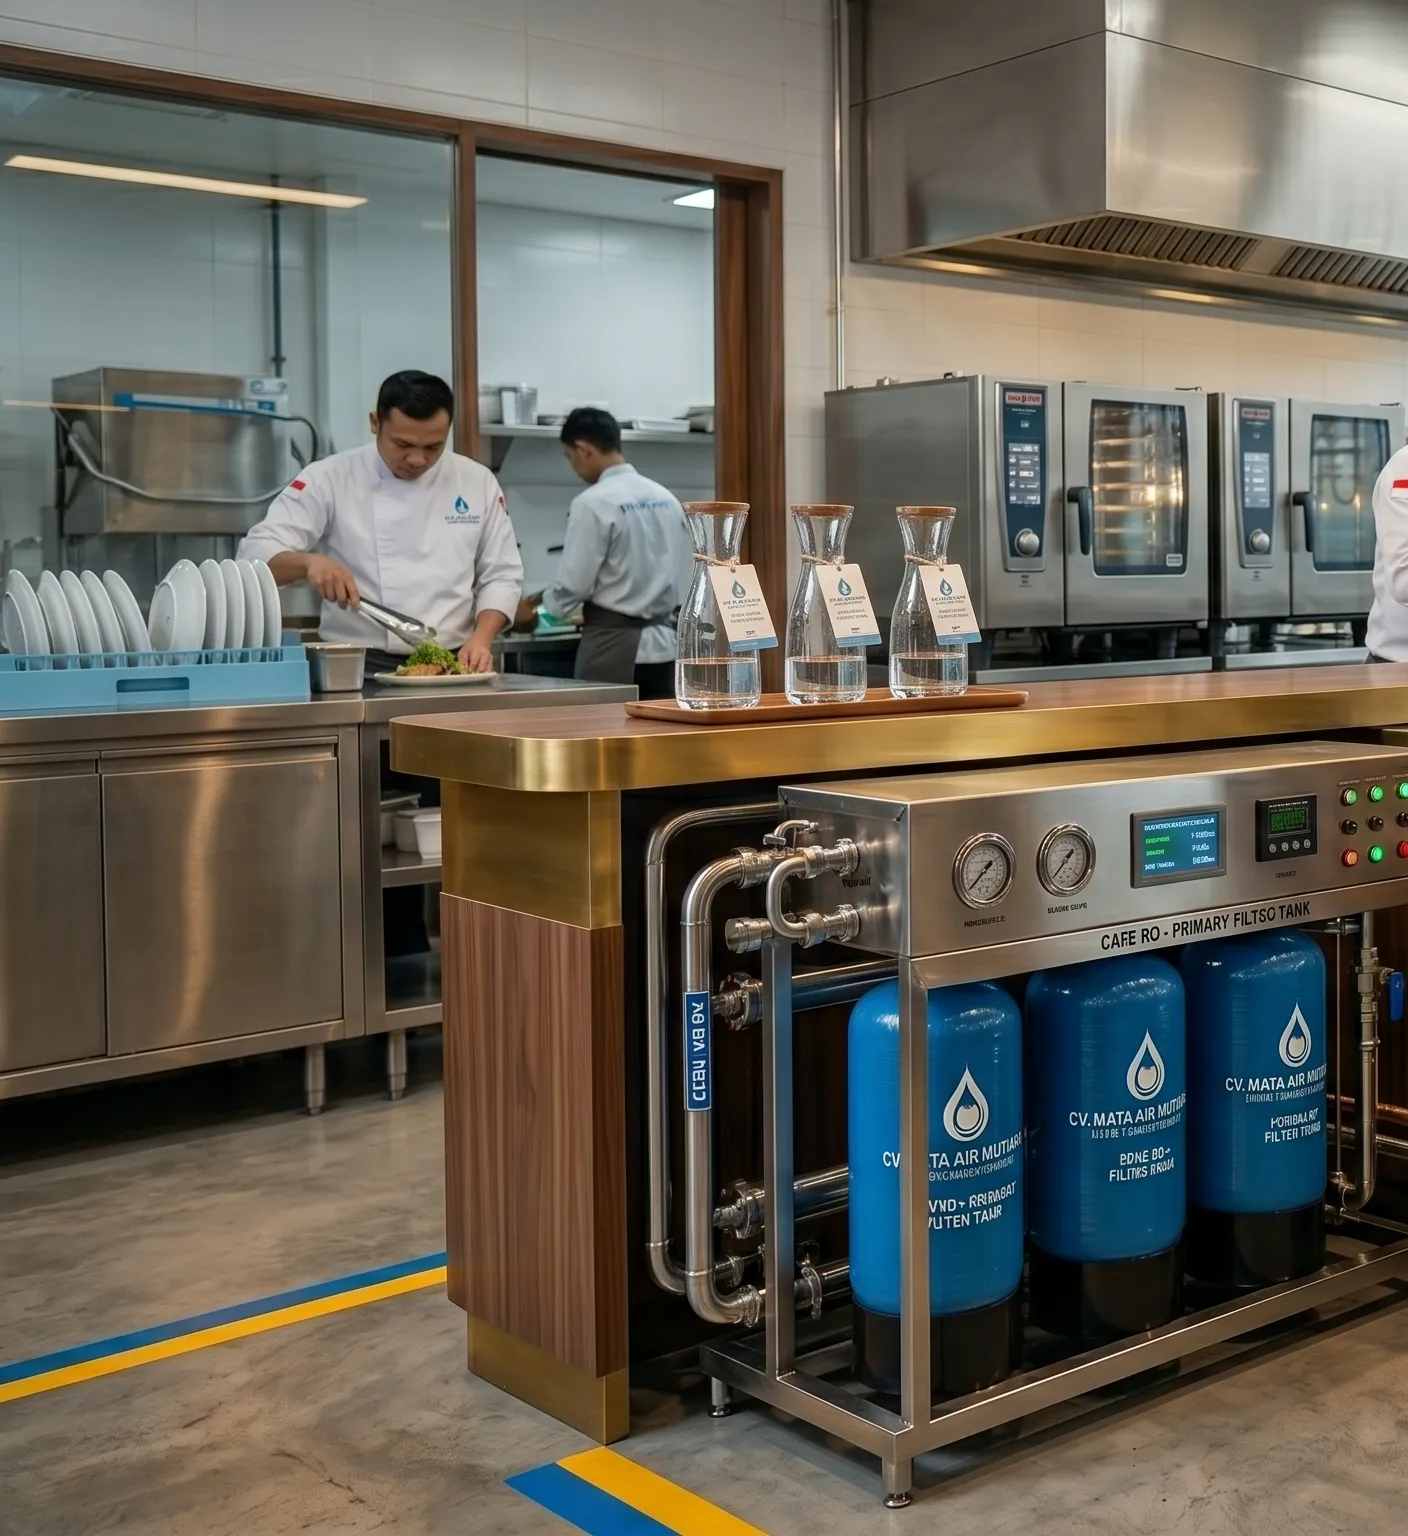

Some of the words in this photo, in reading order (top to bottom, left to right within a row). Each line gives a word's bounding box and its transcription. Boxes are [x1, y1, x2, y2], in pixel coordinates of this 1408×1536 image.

[1101, 930, 1136, 951] CAFE
[1141, 925, 1160, 944] RO
[1172, 914, 1230, 938] PRIMARY
[1279, 901, 1311, 920] TANK
[1225, 1077, 1245, 1092] CV.
[1248, 1077, 1285, 1091] MATA
[1287, 1072, 1305, 1088] AIR
[1069, 1112, 1091, 1127] CV.
[1093, 1111, 1133, 1126] MATA
[1135, 1107, 1155, 1123] AIR
[954, 1149, 979, 1166] AIR
